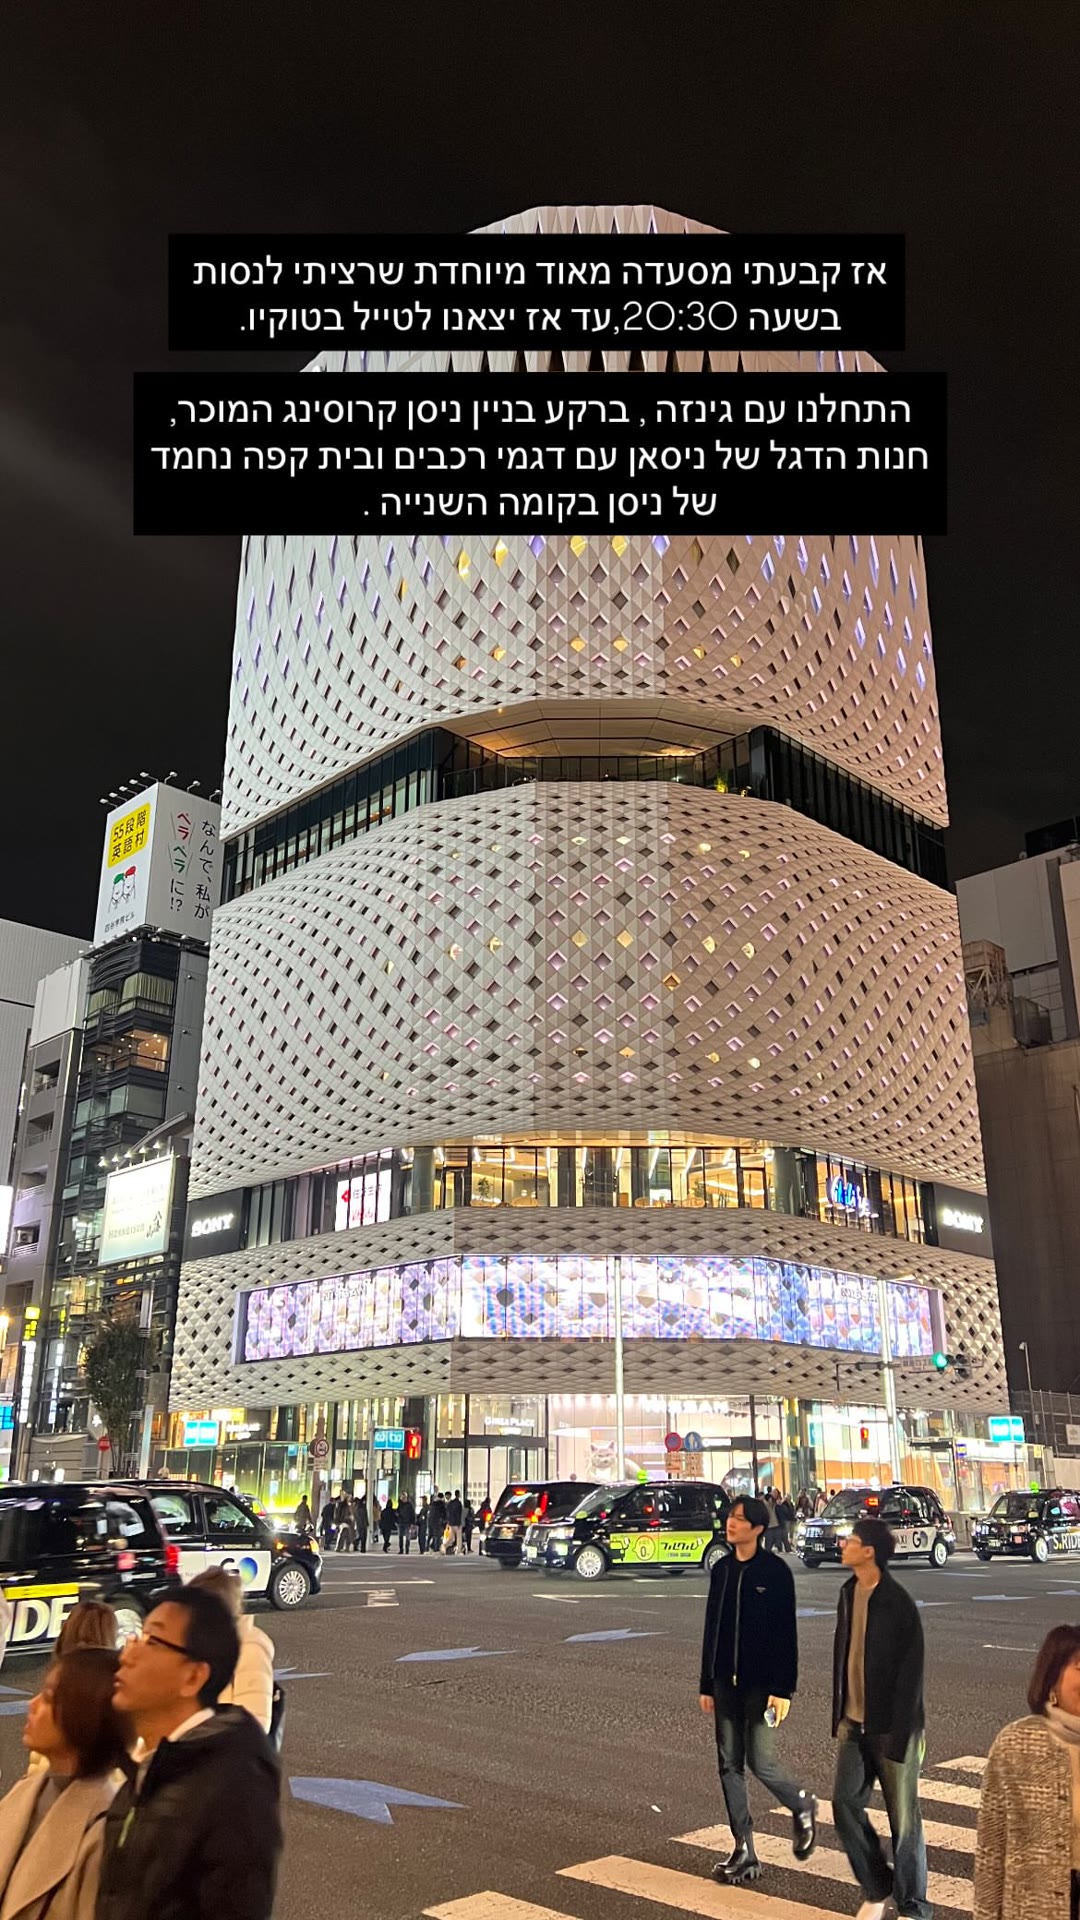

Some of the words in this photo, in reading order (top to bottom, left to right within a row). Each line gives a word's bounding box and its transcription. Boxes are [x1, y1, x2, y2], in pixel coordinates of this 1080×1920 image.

[194, 820, 216, 919] なんで、私が
[191, 1213, 233, 1237] SONY
[943, 1208, 984, 1233] SONY
